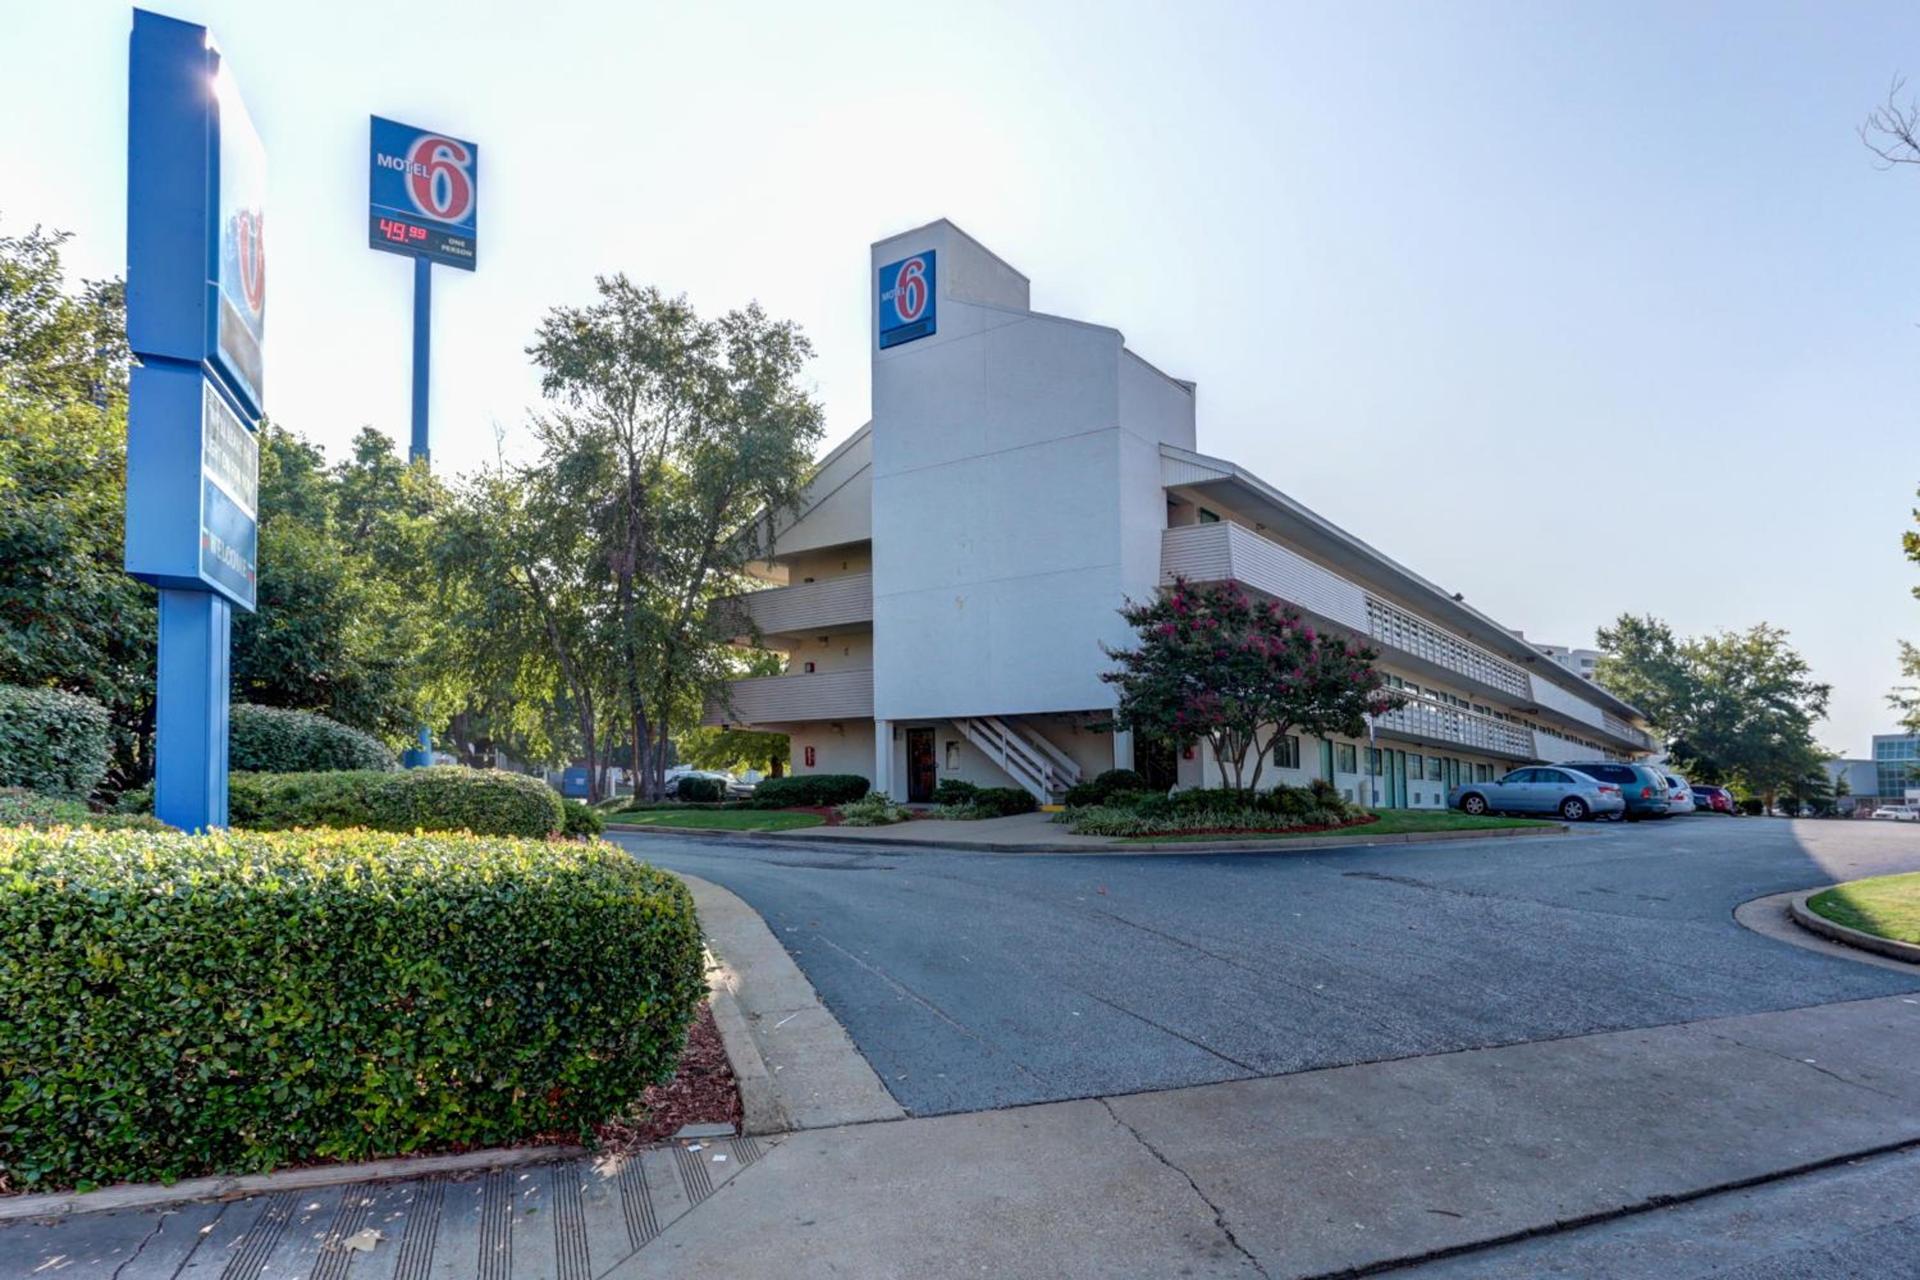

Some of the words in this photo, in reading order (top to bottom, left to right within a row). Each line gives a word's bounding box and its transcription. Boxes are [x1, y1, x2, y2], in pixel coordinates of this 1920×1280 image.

[377, 153, 431, 179] MOTEL
[405, 134, 474, 224] 6
[895, 258, 927, 322] 6
